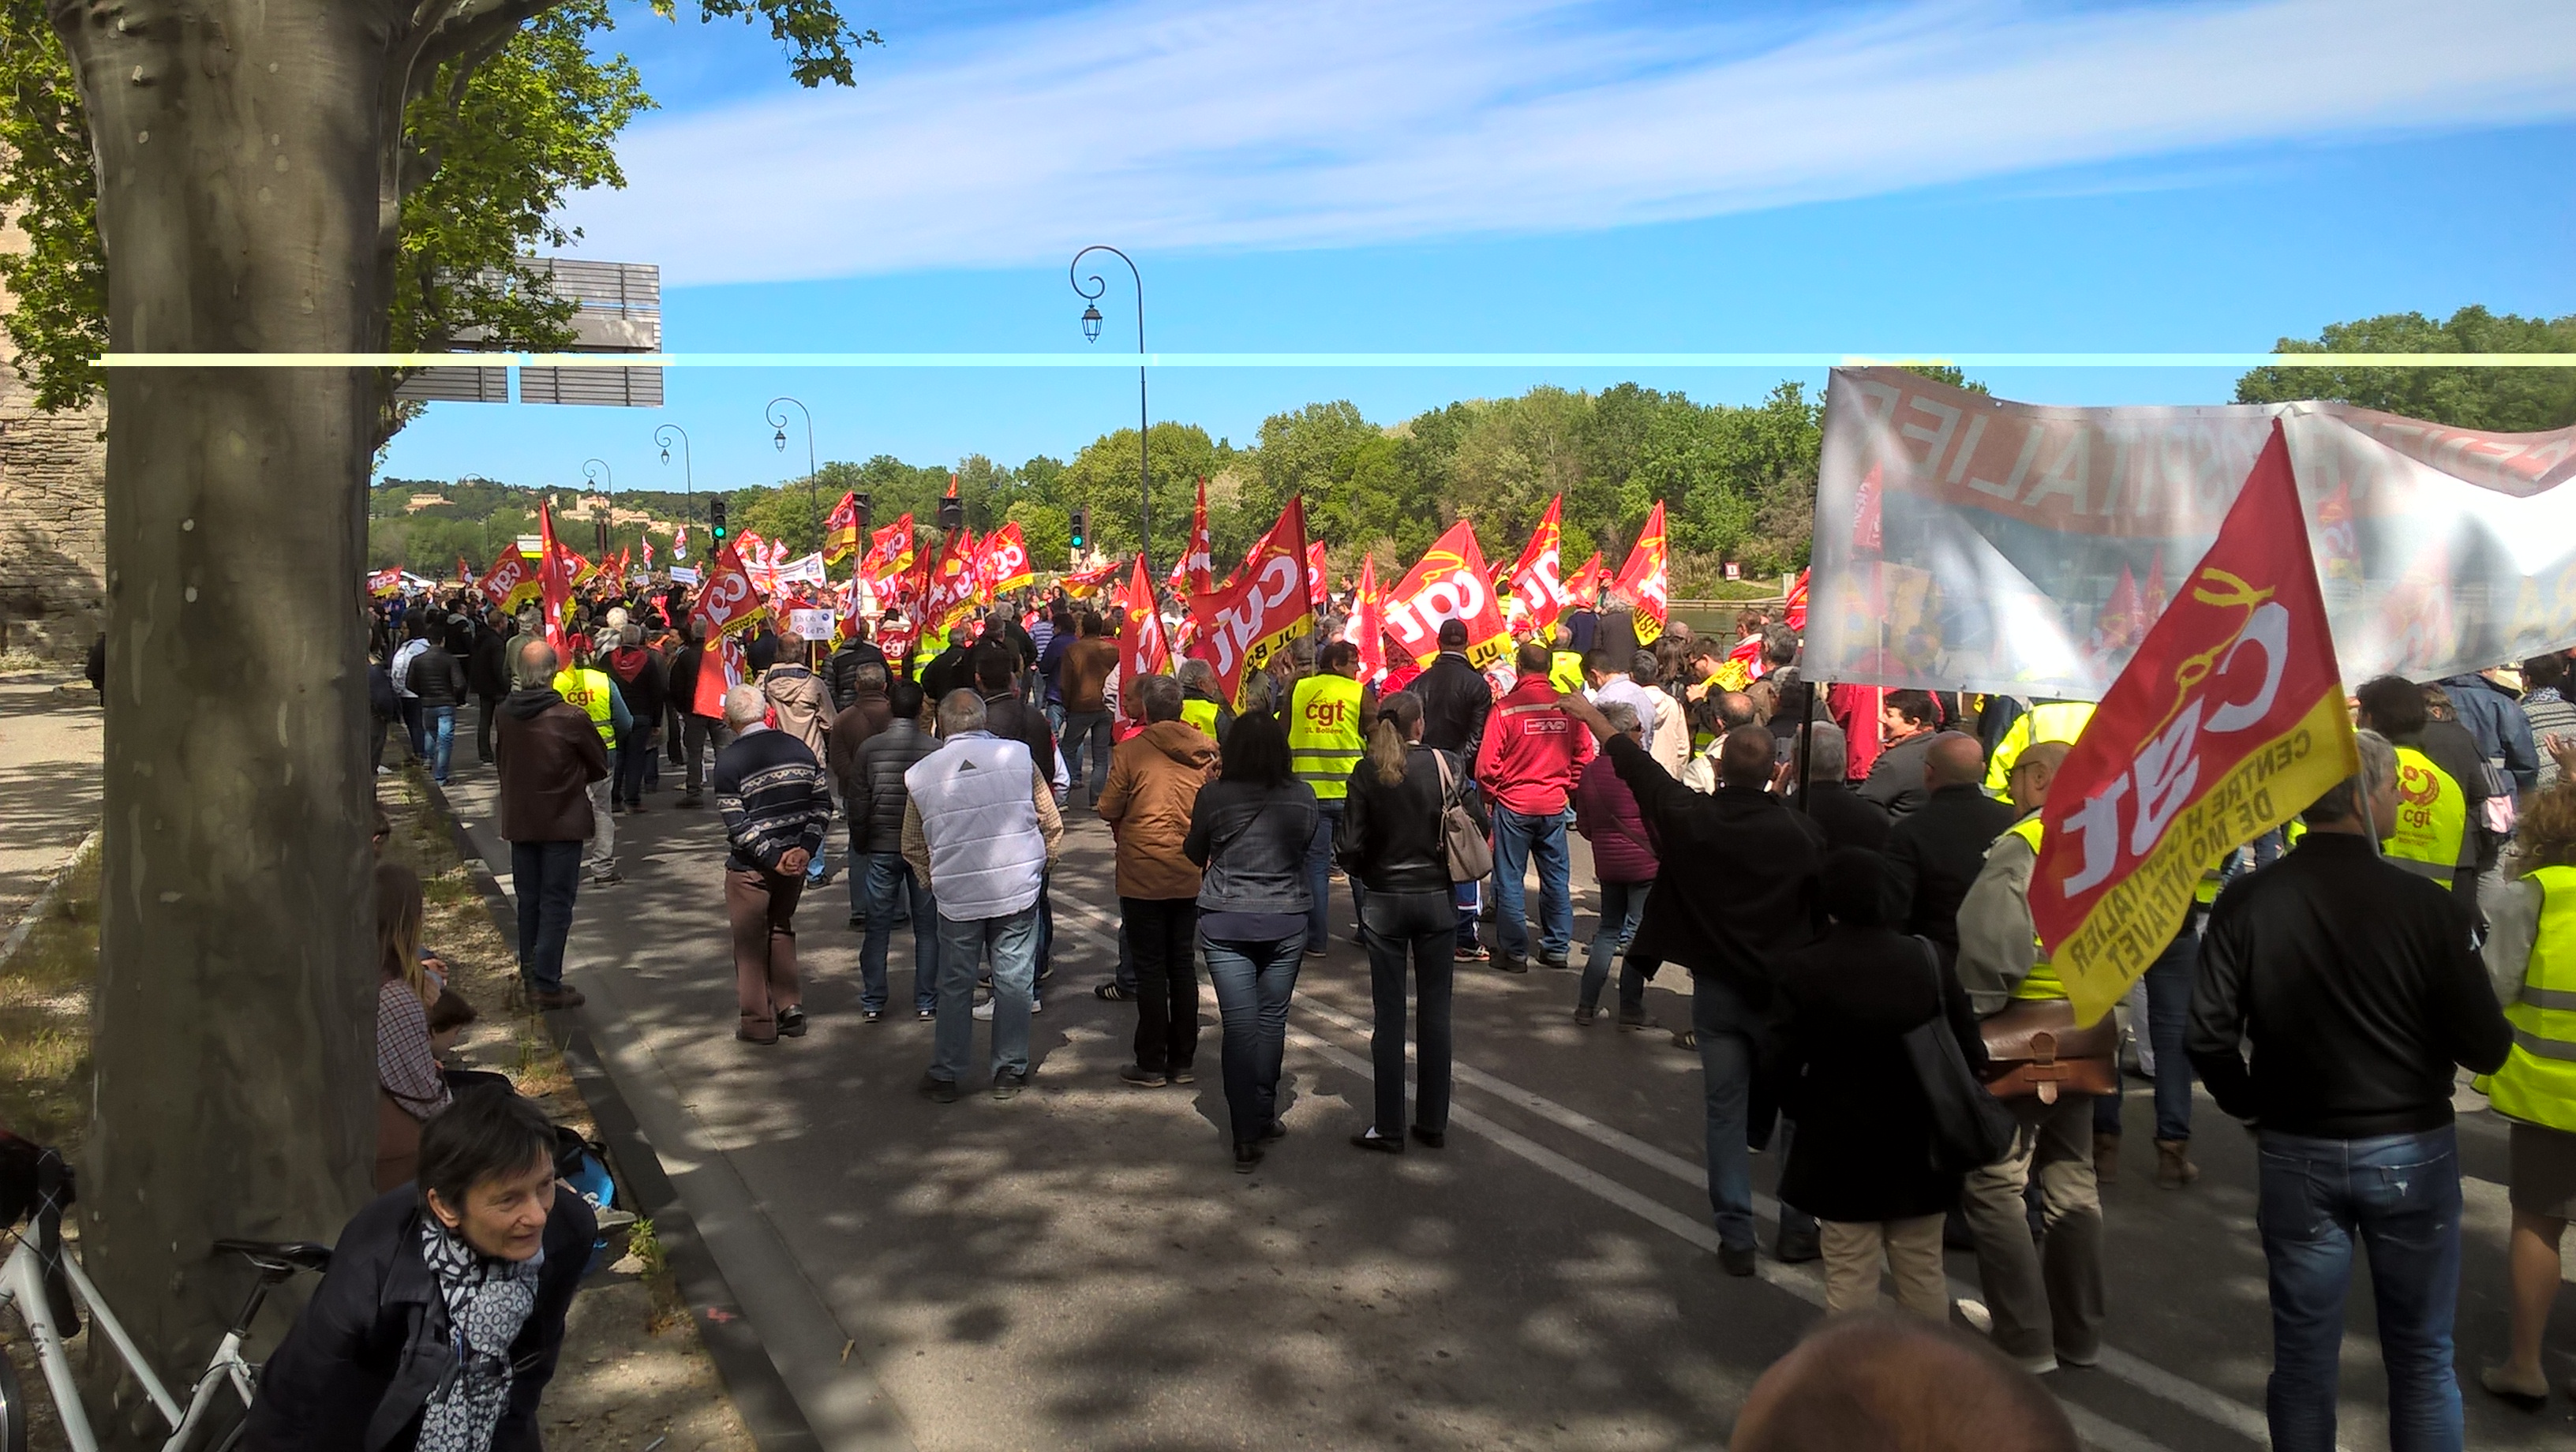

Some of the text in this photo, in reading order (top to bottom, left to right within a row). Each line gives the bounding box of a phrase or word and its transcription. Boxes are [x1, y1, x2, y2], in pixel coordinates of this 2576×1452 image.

[566, 688, 596, 706] cgt
[1305, 699, 1346, 727] cgt
[2403, 808, 2431, 829] cgt
